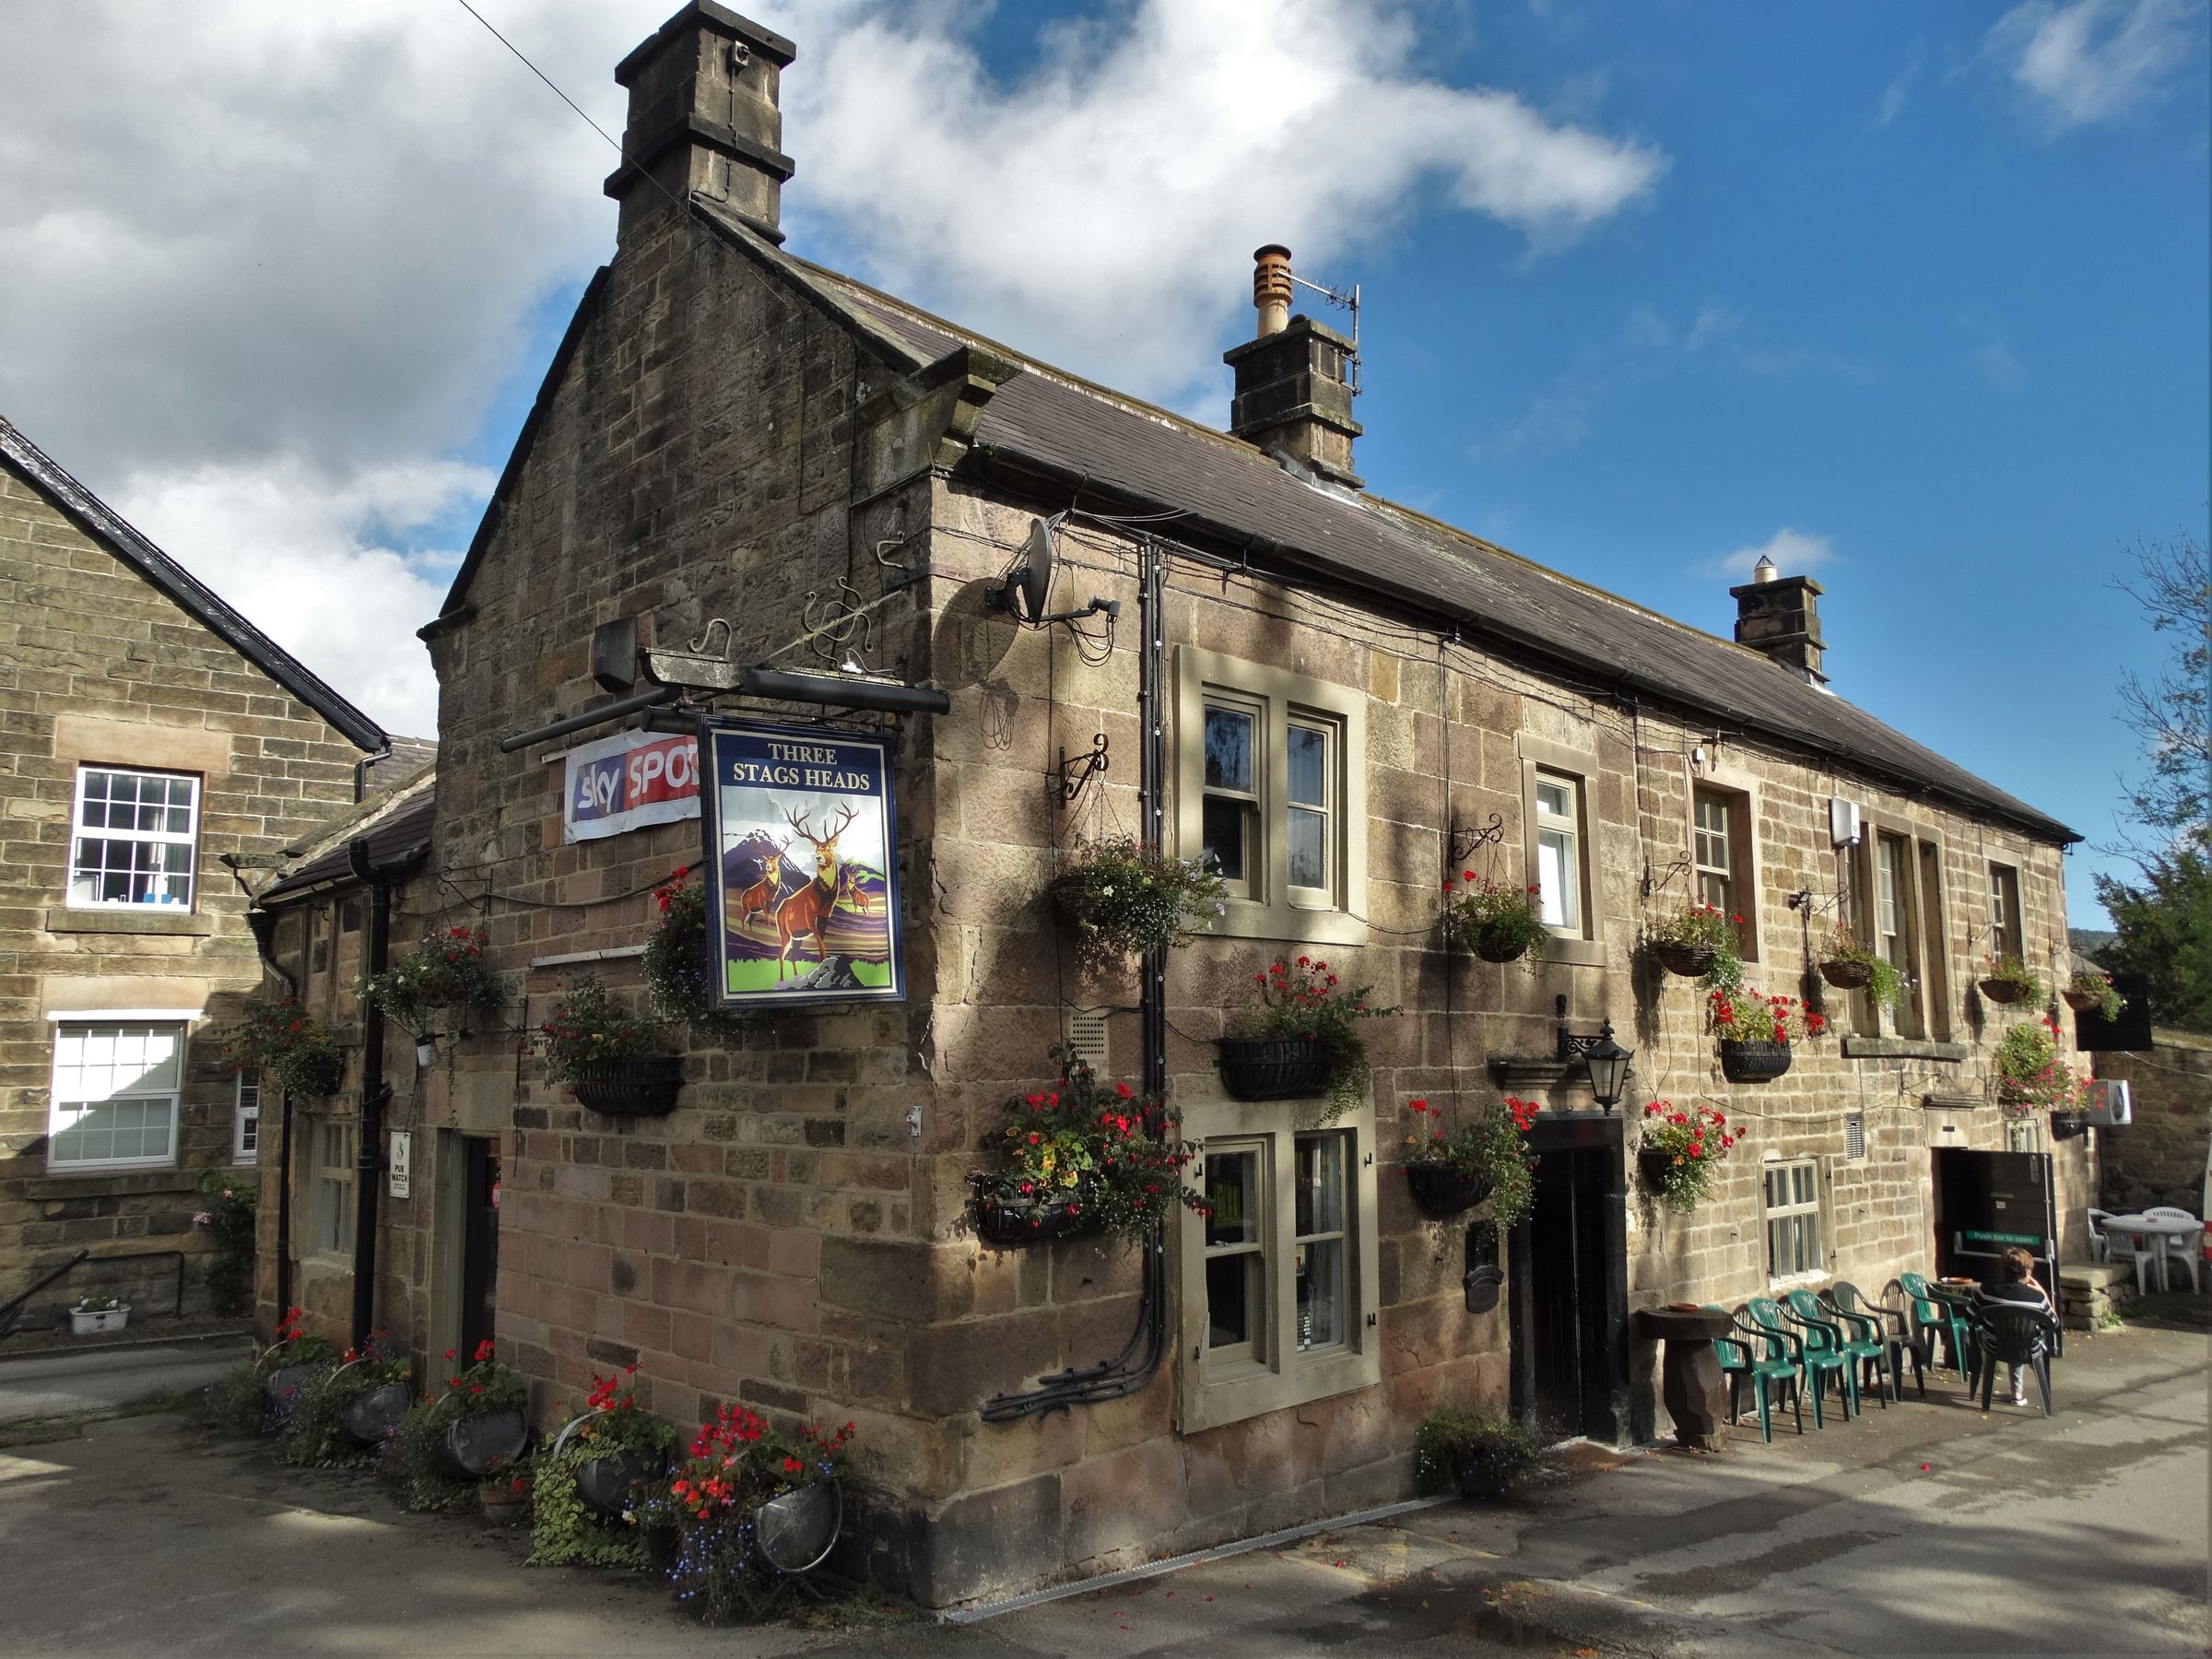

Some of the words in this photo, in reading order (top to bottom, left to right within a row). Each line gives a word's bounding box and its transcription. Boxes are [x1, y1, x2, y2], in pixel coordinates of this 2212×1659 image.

[768, 743, 838, 765] THREE
[734, 763, 800, 784] STAGS
[805, 769, 870, 791] HEADS
[394, 1164, 404, 1172] PUB
[392, 1173, 408, 1182] WATCH
[1974, 1231, 1992, 1240] Push
[1993, 1233, 2005, 1241] bar
[2015, 1236, 2033, 1245] open
